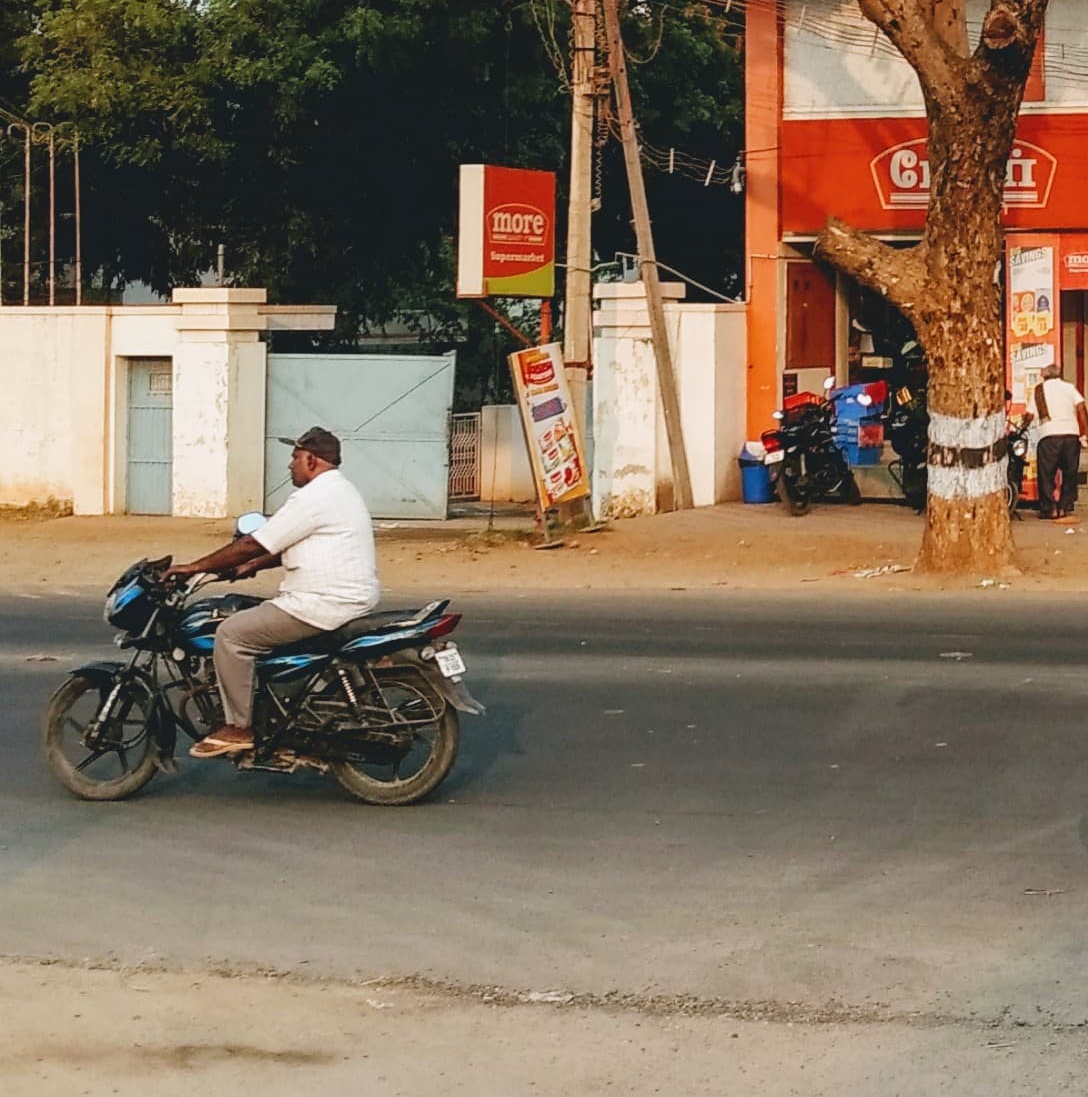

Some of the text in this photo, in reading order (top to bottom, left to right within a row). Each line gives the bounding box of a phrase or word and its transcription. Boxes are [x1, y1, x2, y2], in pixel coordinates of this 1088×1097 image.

[492, 211, 545, 235] more
[1010, 247, 1048, 267] SAVINGS
[1010, 342, 1048, 364] SAVINGS
